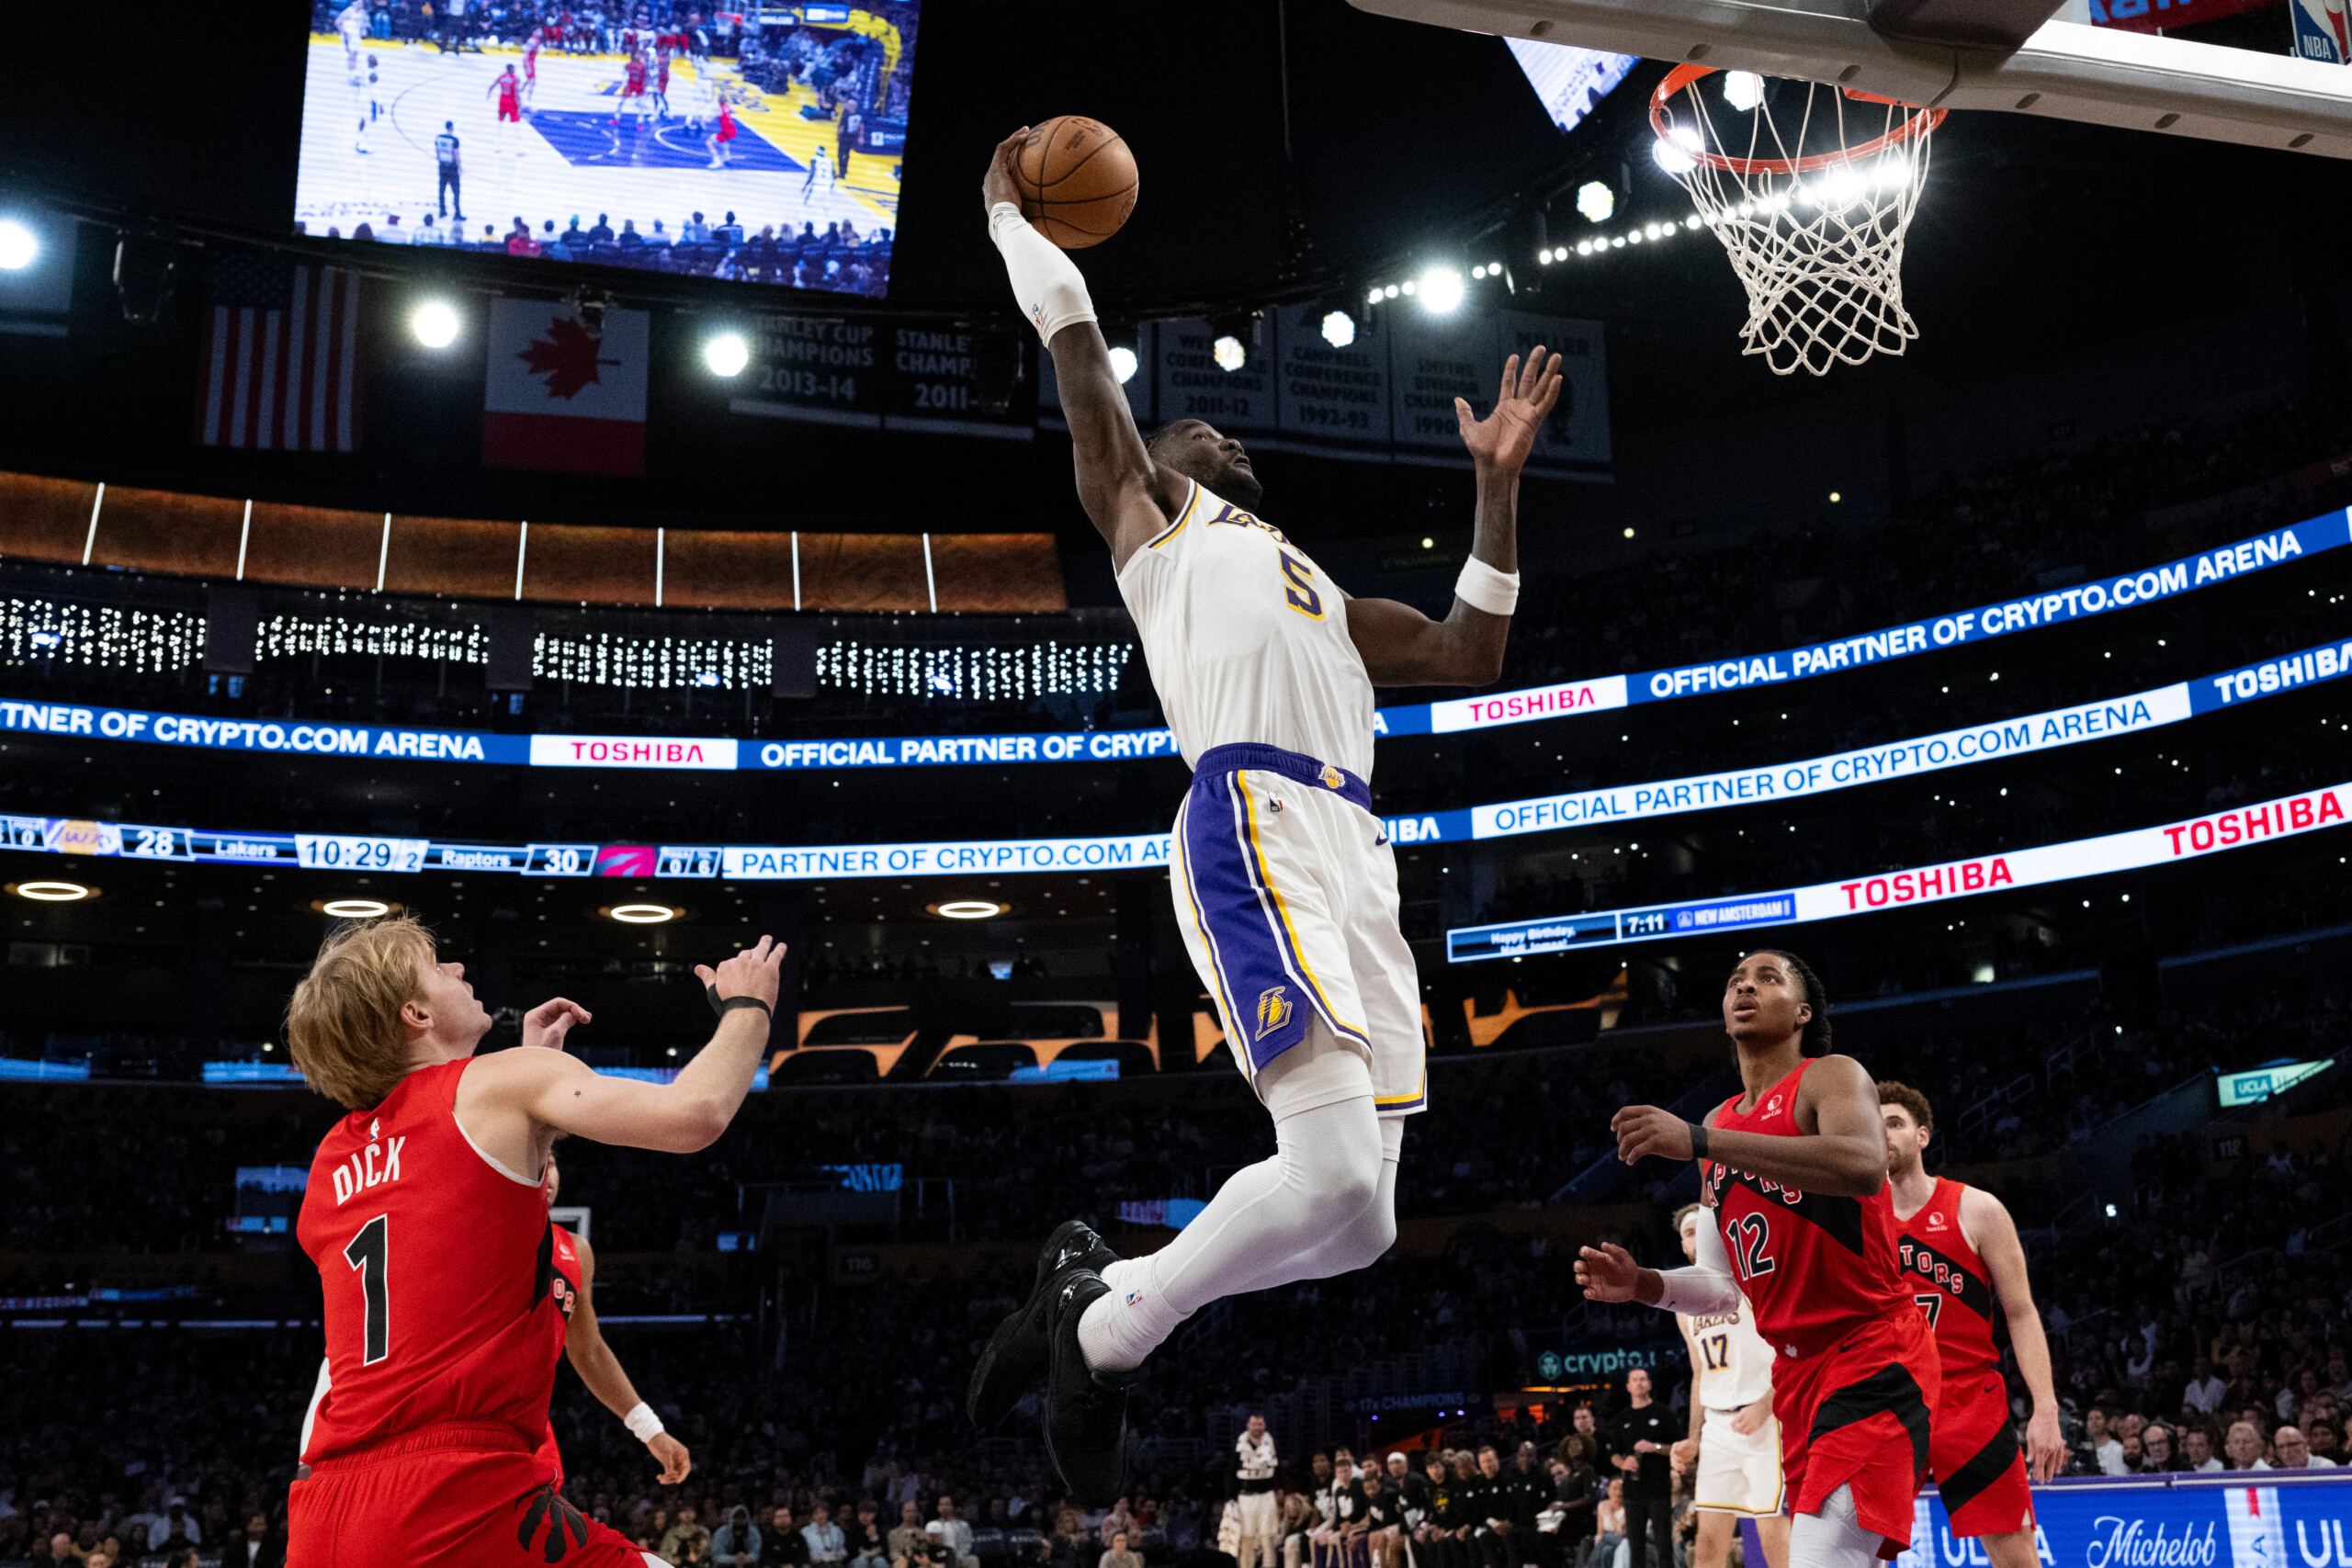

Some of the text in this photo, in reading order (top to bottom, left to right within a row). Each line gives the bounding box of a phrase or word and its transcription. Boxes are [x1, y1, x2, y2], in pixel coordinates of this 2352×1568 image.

[2302, 34, 2333, 60] NBA
[833, 325, 874, 344] CUP
[896, 329, 970, 354] STANLE
[1293, 345, 1372, 367] CAMPBELL
[760, 365, 855, 401] 2013-14
[1170, 370, 1263, 391] CHAMPIONS
[1284, 362, 1382, 386] CONFERENCE
[1290, 378, 1378, 403] CHAMPIONS
[1186, 396, 1250, 416] 2011-12
[1299, 404, 1369, 428] 1992-93
[1276, 546, 1326, 622] 5
[1649, 530, 2303, 698] OFFICIAL PARTNER OF CRYPTO.COM ARENA
[1469, 687, 1595, 722] TOSHIBA
[99, 711, 150, 739] OF
[153, 716, 368, 755] CRYPTO.COM
[374, 731, 485, 761] ARENA
[571, 742, 704, 764] TOSHIBA
[761, 739, 895, 767] OFFICIAL
[900, 736, 1037, 765] PARTNER
[1041, 735, 1084, 761] OF
[1495, 700, 2152, 830] OFFICIAL PARTNER OF CRYPTO.COM ARENA
[2163, 791, 2345, 855] TOSHIBA
[136, 830, 175, 856] 28
[215, 840, 277, 858] Lakers
[305, 840, 391, 867] 10:29
[407, 851, 418, 869] 2
[441, 850, 511, 869] Raptors
[544, 849, 580, 874] 30
[742, 852, 880, 874] PARTNER
[888, 849, 928, 871] OF
[935, 842, 1131, 868] CRYPTO.COM
[1840, 857, 2013, 910] TOSHIBA
[1627, 913, 1664, 935] 7:11
[1694, 908, 1718, 926] NEW
[1718, 901, 1782, 923] AMSTERDAM
[2237, 1077, 2270, 1095] UCLA
[333, 1135, 406, 1207] DICK
[1726, 1212, 1775, 1281] 12
[343, 1213, 389, 1368] 1
[1701, 1333, 1730, 1372] 17
[1380, 1391, 1465, 1410] CHAMPIONS
[2086, 1516, 2216, 1568] Michelob
